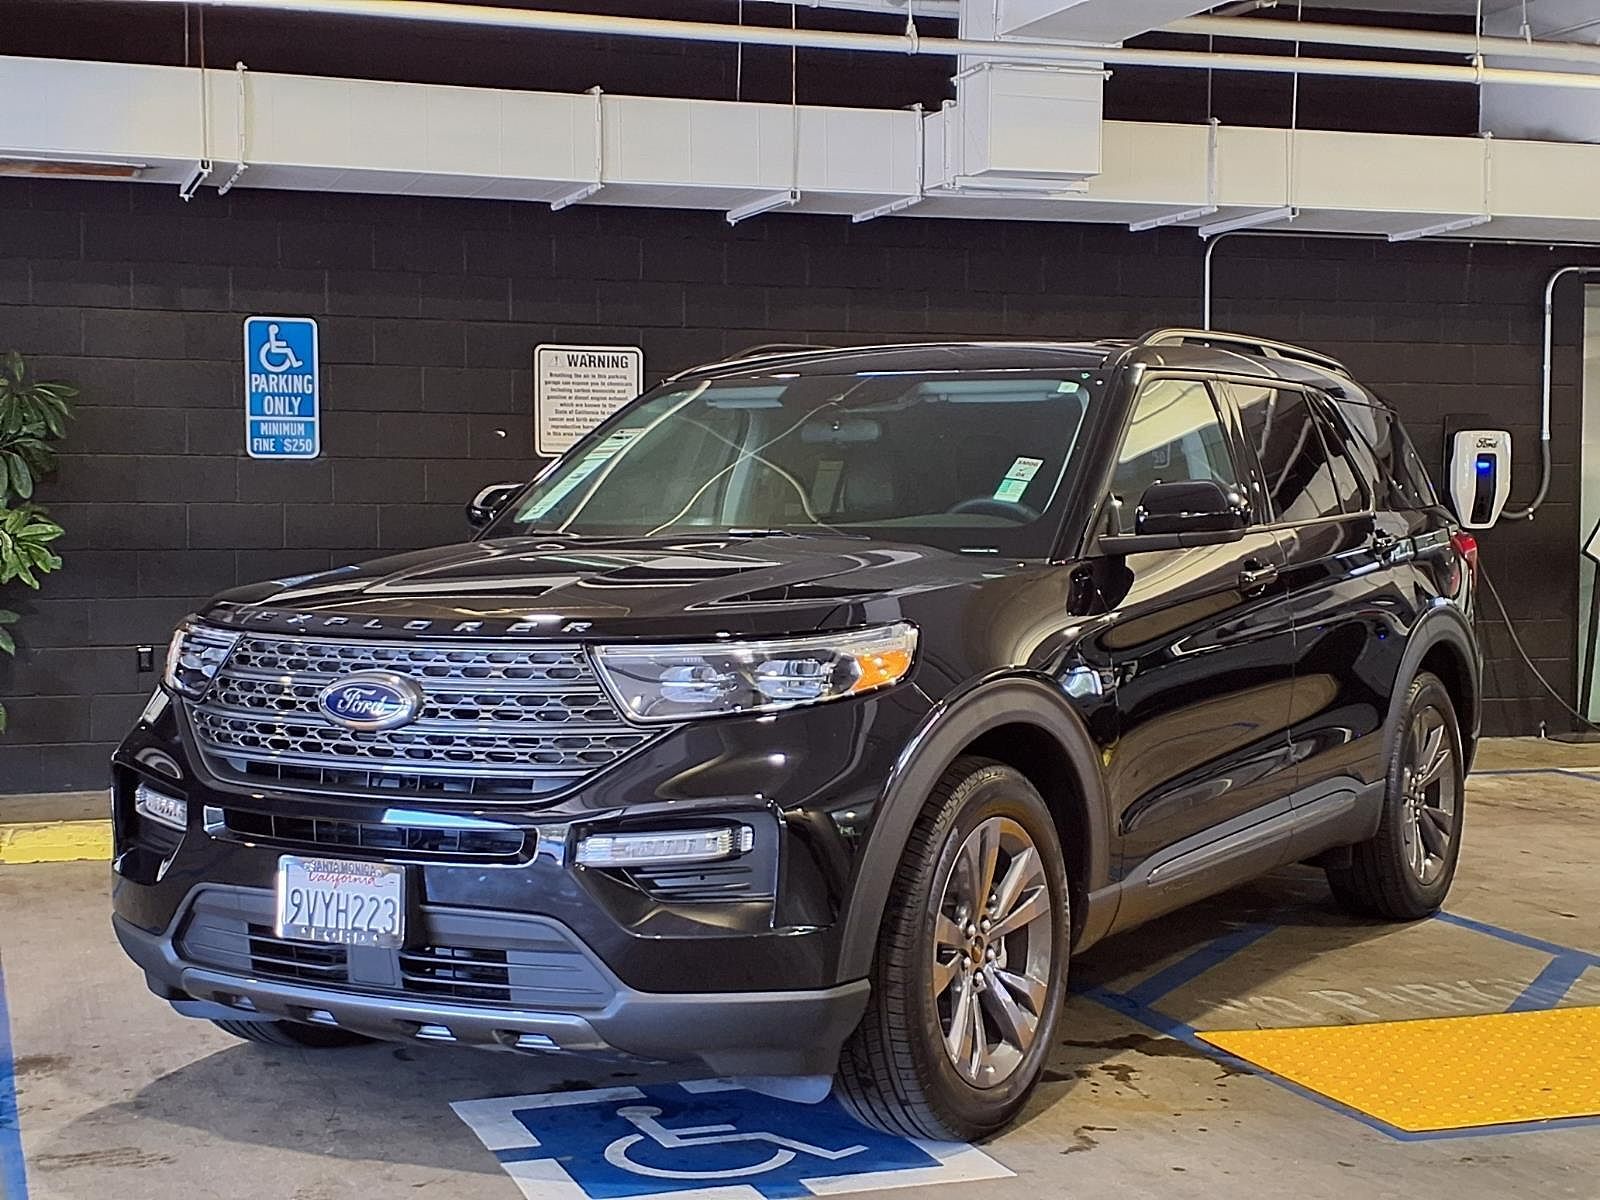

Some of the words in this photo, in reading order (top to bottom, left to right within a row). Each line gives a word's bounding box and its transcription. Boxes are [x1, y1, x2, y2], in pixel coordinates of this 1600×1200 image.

[567, 353, 629, 368] WARNING
[251, 374, 313, 394] PARKING
[263, 395, 302, 415] ONLY
[260, 422, 305, 436] MINIMUM
[253, 438, 276, 452] FINE
[283, 438, 312, 452] $250
[1476, 438, 1498, 448] Ford
[254, 610, 593, 633] EXPLORER
[336, 686, 391, 716] Ford
[312, 859, 339, 873] SANTA
[340, 862, 376, 877] MONICA
[309, 871, 377, 889] California
[290, 888, 397, 933] 9VYH223
